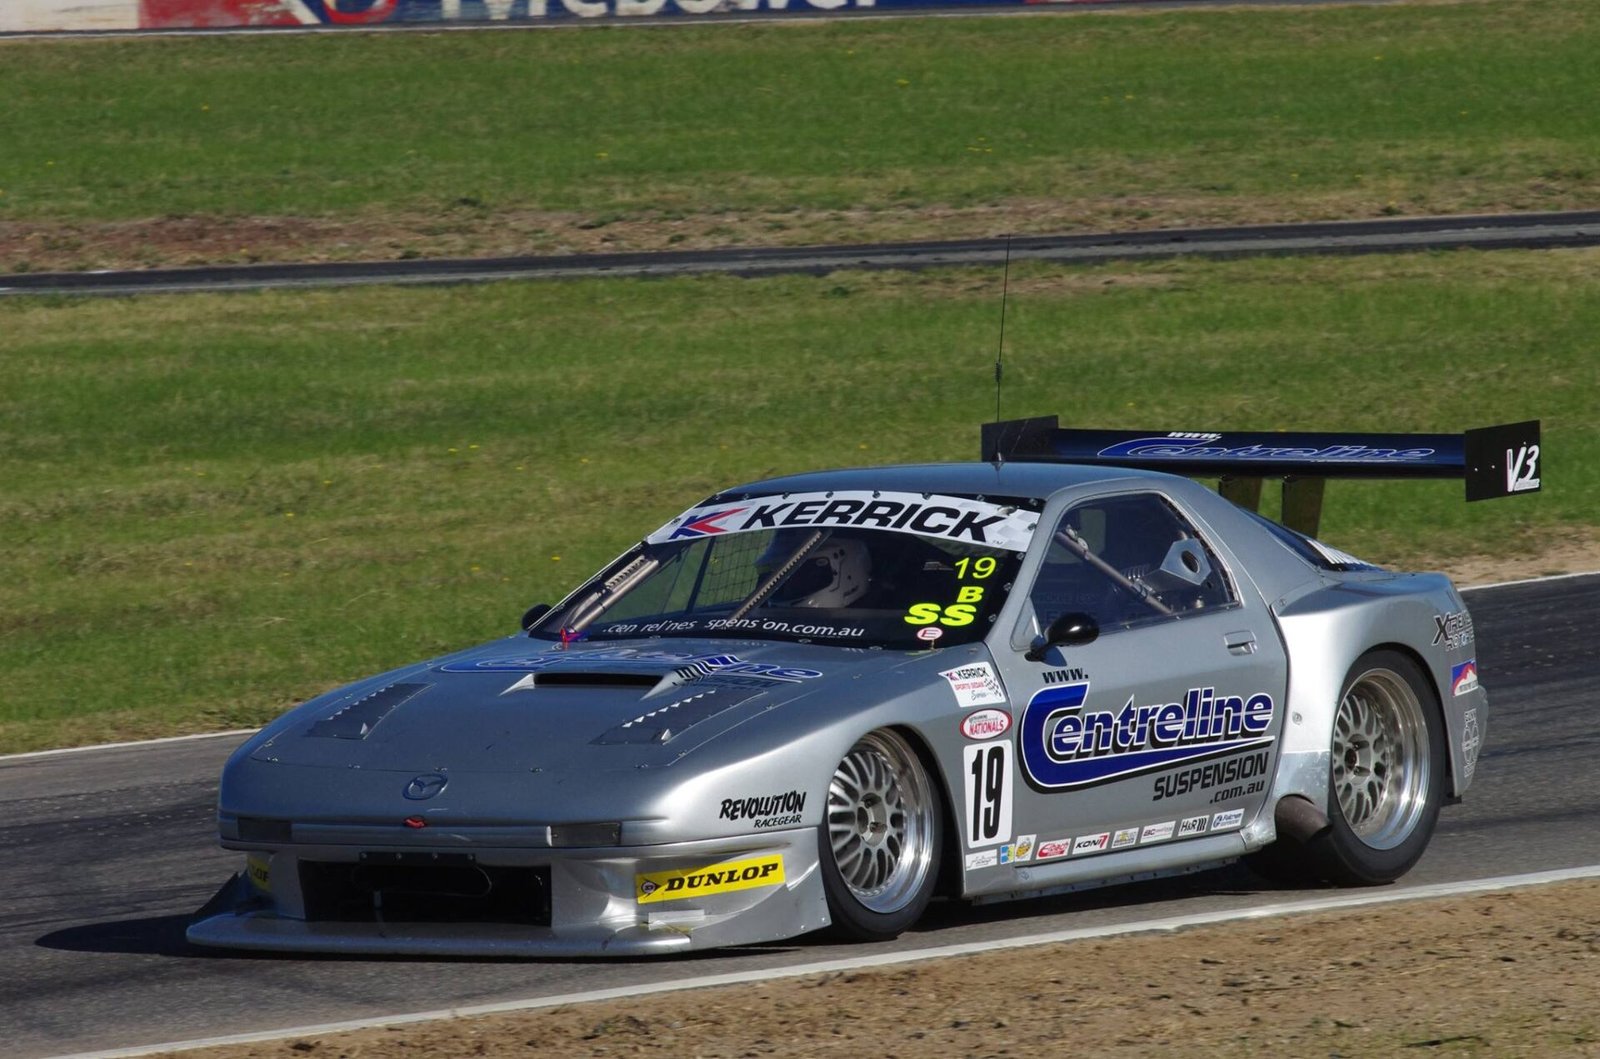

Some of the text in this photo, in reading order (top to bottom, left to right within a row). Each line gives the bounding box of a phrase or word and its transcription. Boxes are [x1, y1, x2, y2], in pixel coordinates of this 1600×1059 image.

[1097, 437, 1435, 459] Centreline
[1506, 445, 1540, 492] V3
[740, 500, 1007, 543] KERRICK
[955, 557, 996, 579] 19
[957, 586, 984, 603] B
[904, 603, 977, 626] SS
[956, 667, 989, 680] KERRICK
[1042, 668, 1088, 684] www.
[968, 719, 1004, 735] NATIONALS
[1018, 681, 1275, 794] Centreline
[1153, 751, 1269, 801] SUSPENSION
[971, 745, 1004, 842] 19
[1209, 781, 1265, 804] .com.au
[719, 790, 806, 821] REVOLUTION
[754, 814, 802, 829] RACEGEAR
[1180, 818, 1198, 832] H&R
[1075, 836, 1105, 850] KONI
[664, 863, 778, 892] DUNLOP
